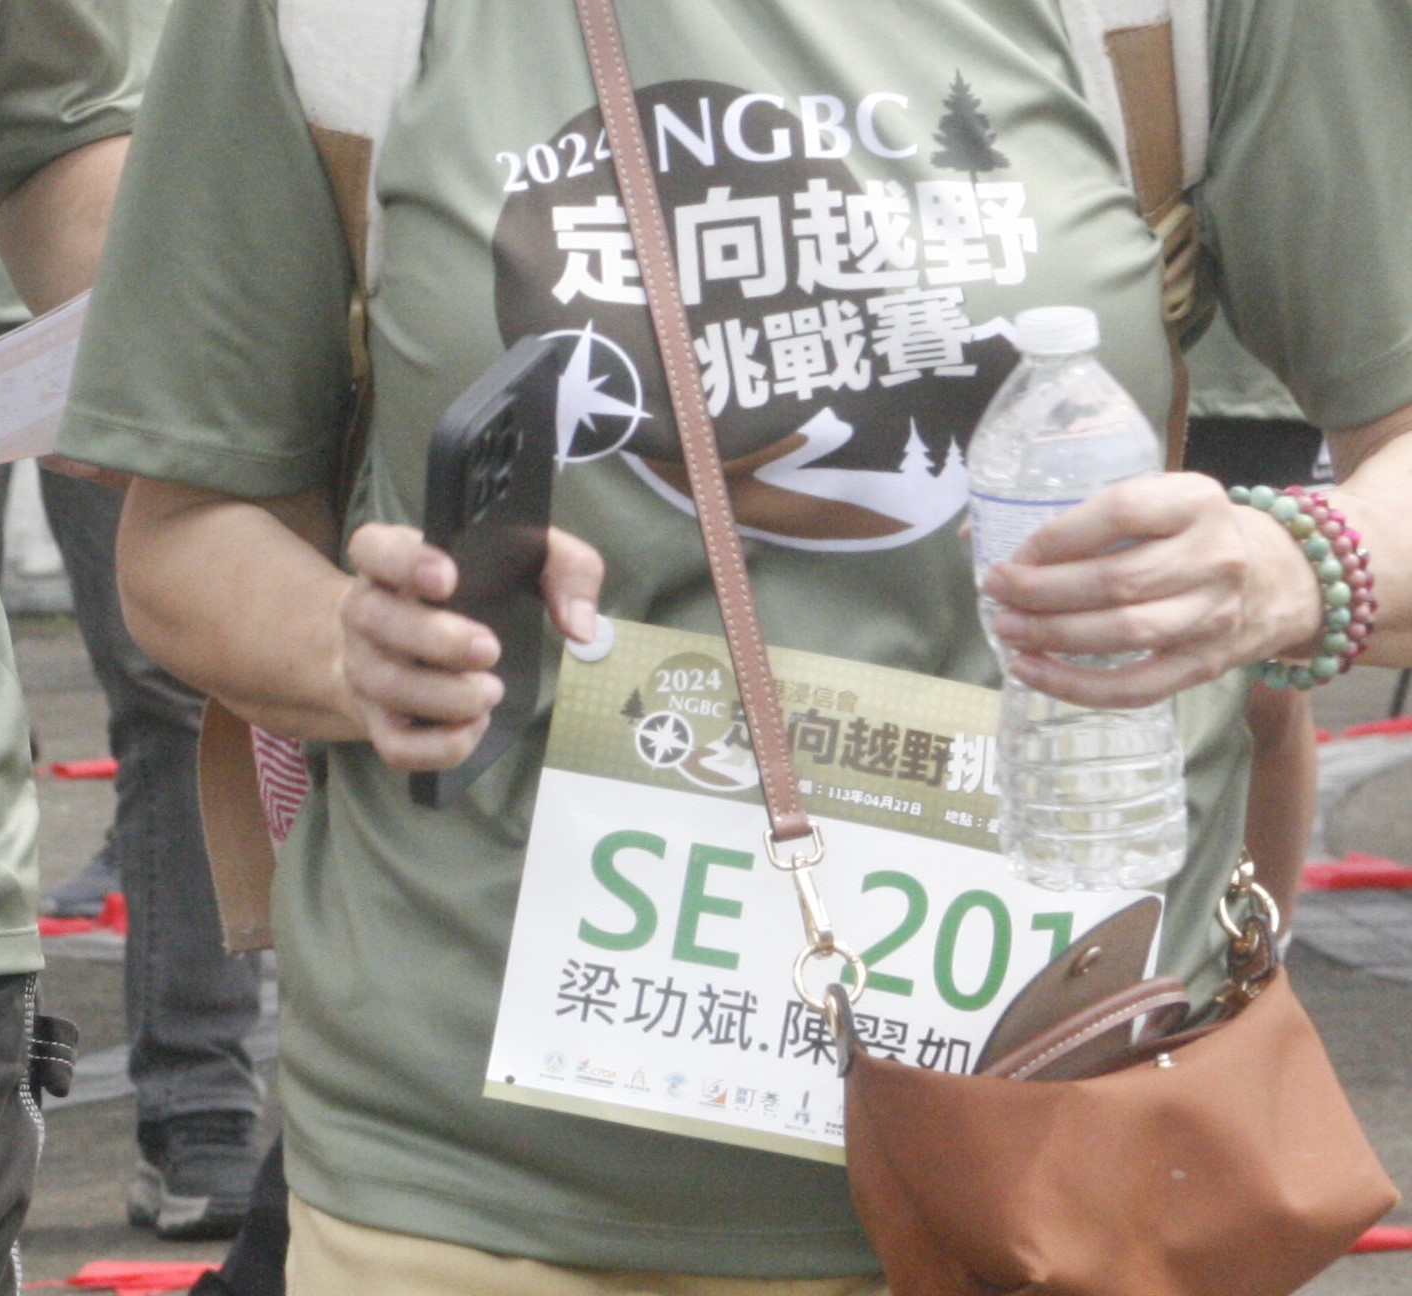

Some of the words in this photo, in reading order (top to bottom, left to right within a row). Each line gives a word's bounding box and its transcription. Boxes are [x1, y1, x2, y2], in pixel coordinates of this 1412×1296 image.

[653, 92, 919, 173] NGBC
[551, 178, 1038, 305] 定向越野
[655, 668, 723, 693] 2024
[669, 695, 726, 719] NGBC
[577, 829, 755, 971] SE
